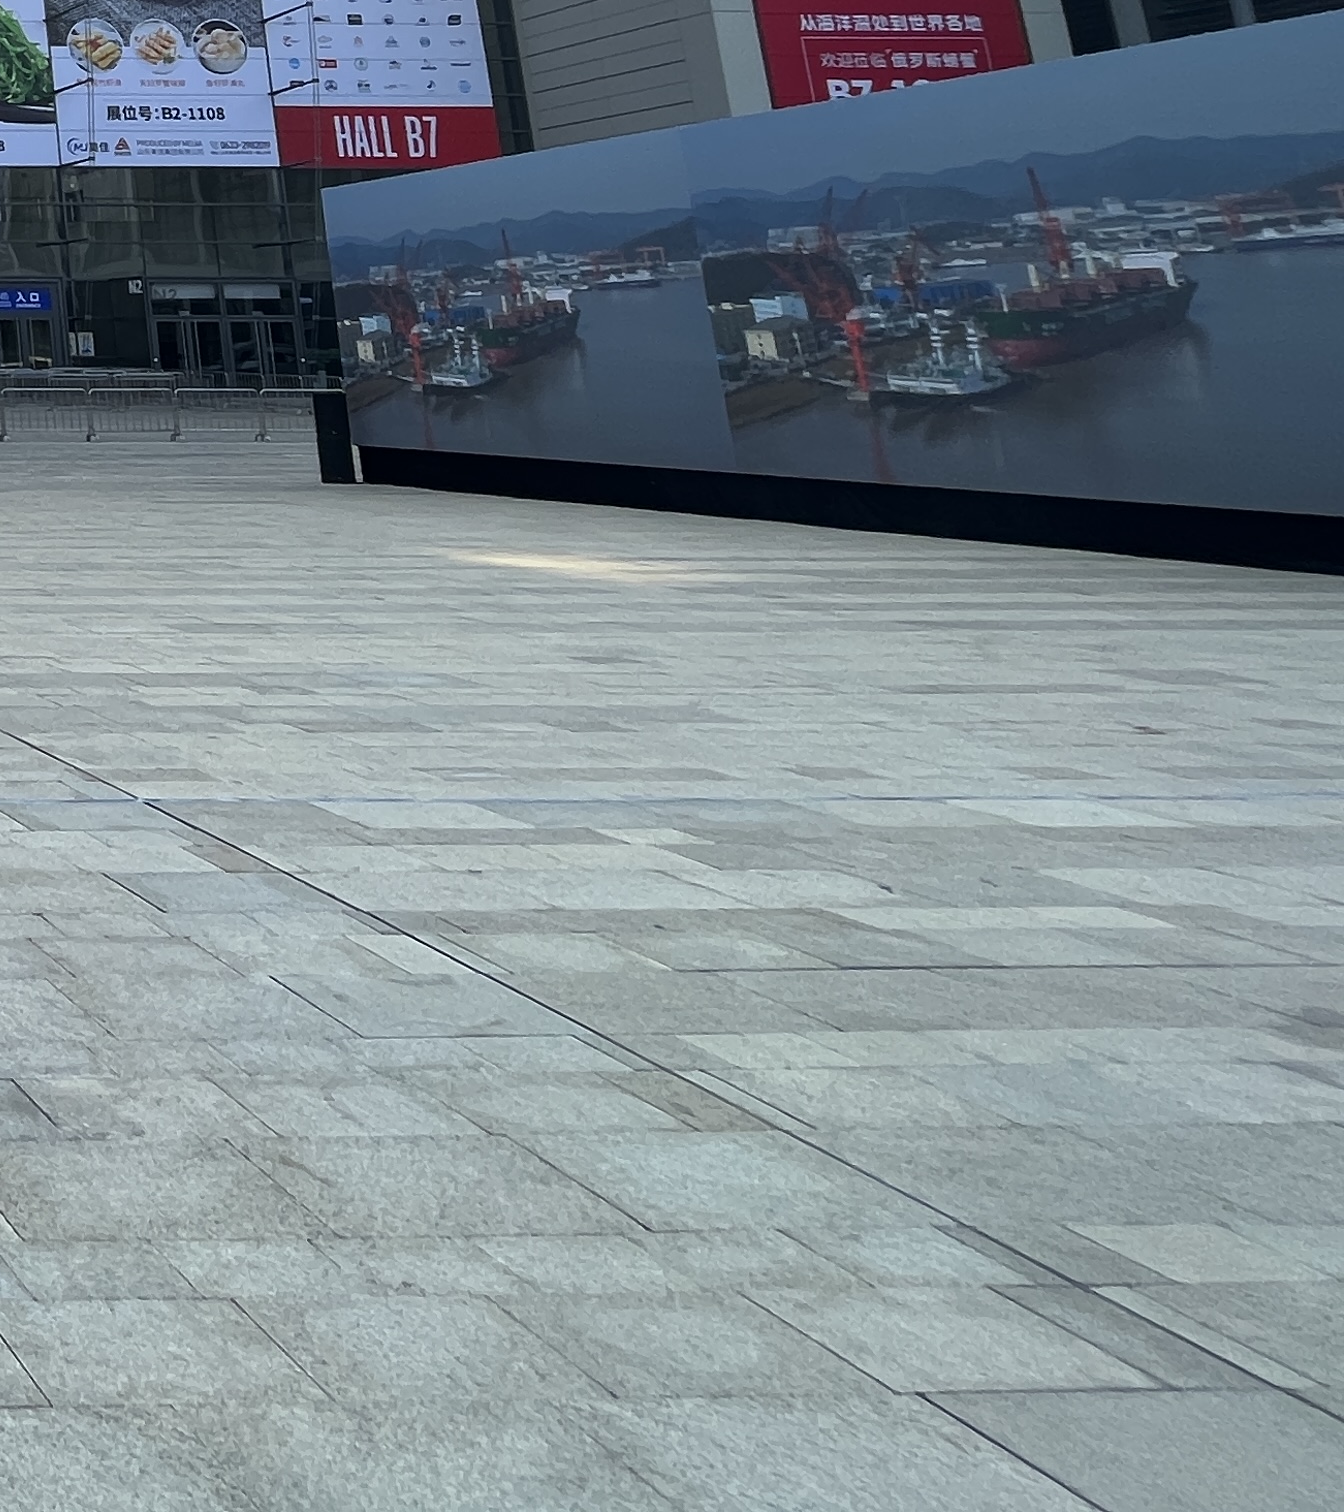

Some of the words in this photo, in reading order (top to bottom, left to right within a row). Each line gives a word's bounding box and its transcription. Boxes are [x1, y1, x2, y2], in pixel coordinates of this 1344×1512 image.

[333, 115, 399, 157] HALL
[404, 116, 438, 158] B7
[15, 291, 40, 302] 入口
